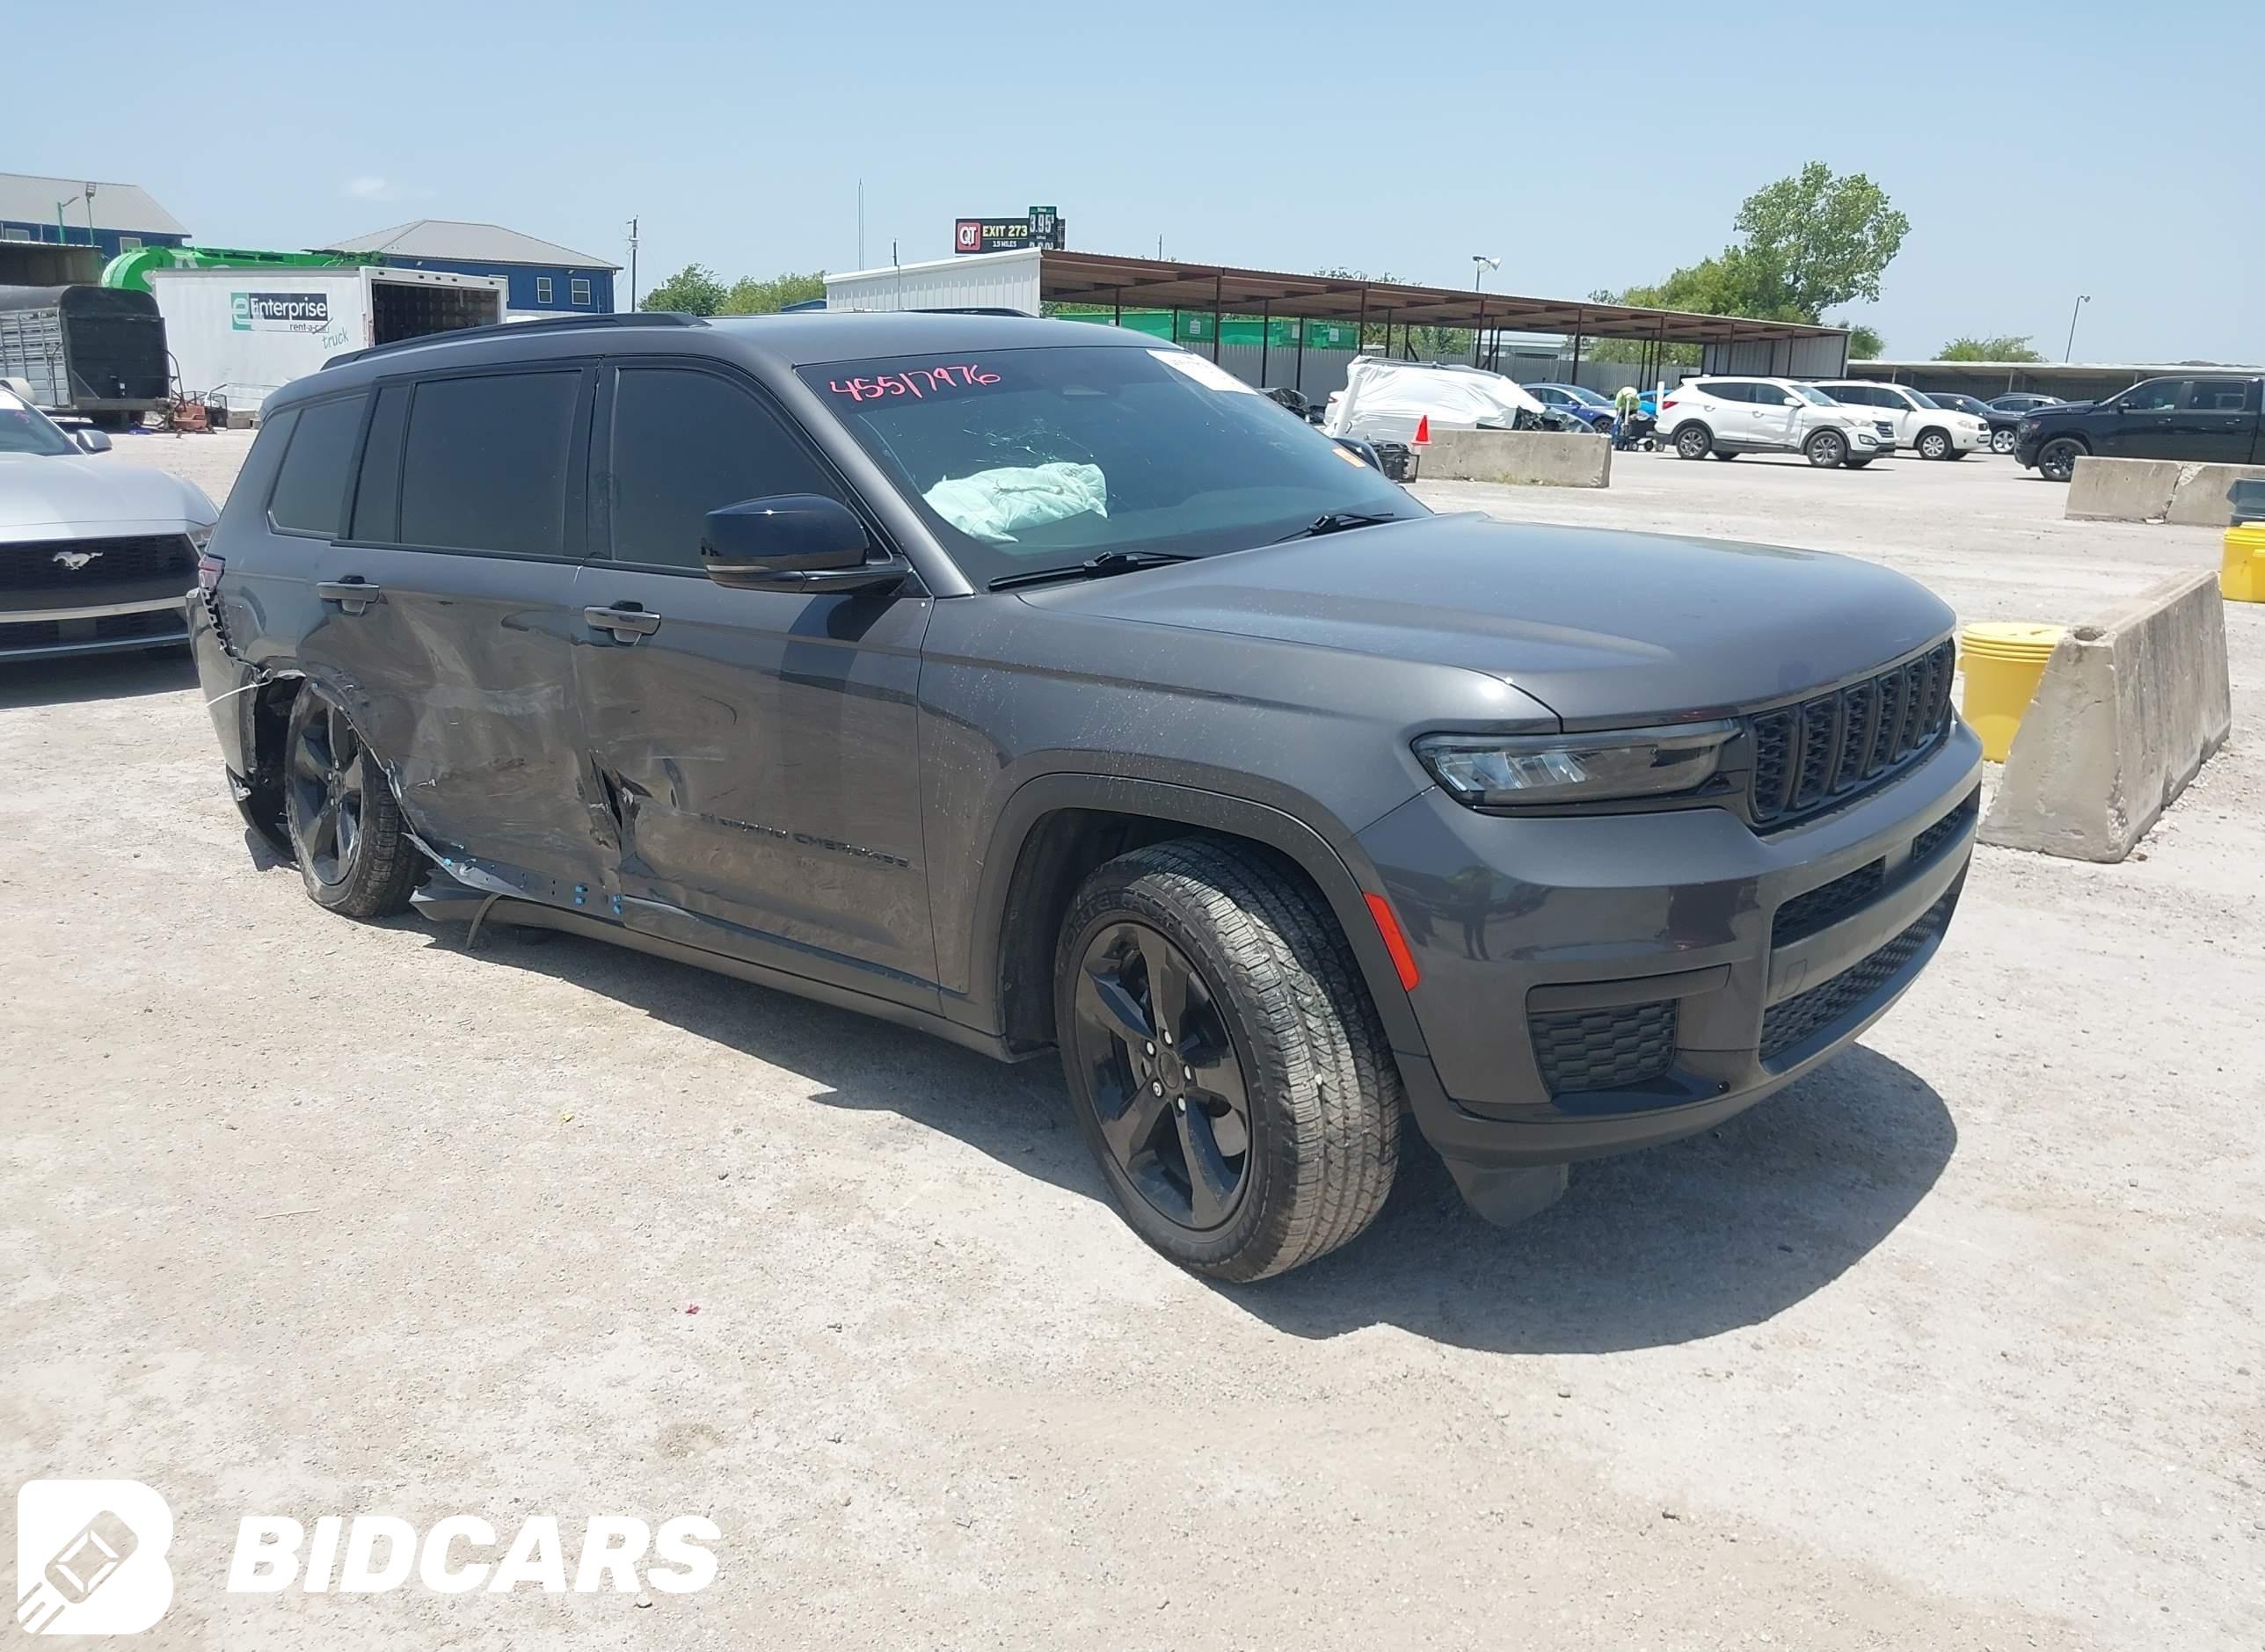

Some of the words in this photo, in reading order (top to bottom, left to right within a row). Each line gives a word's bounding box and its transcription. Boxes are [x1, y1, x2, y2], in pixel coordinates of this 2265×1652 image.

[959, 226, 977, 246] QT
[982, 225, 1006, 237] EXIT
[1008, 225, 1028, 237] 273
[250, 296, 327, 321] Enterprise
[321, 328, 349, 350] truck
[830, 364, 1001, 402] 45517976
